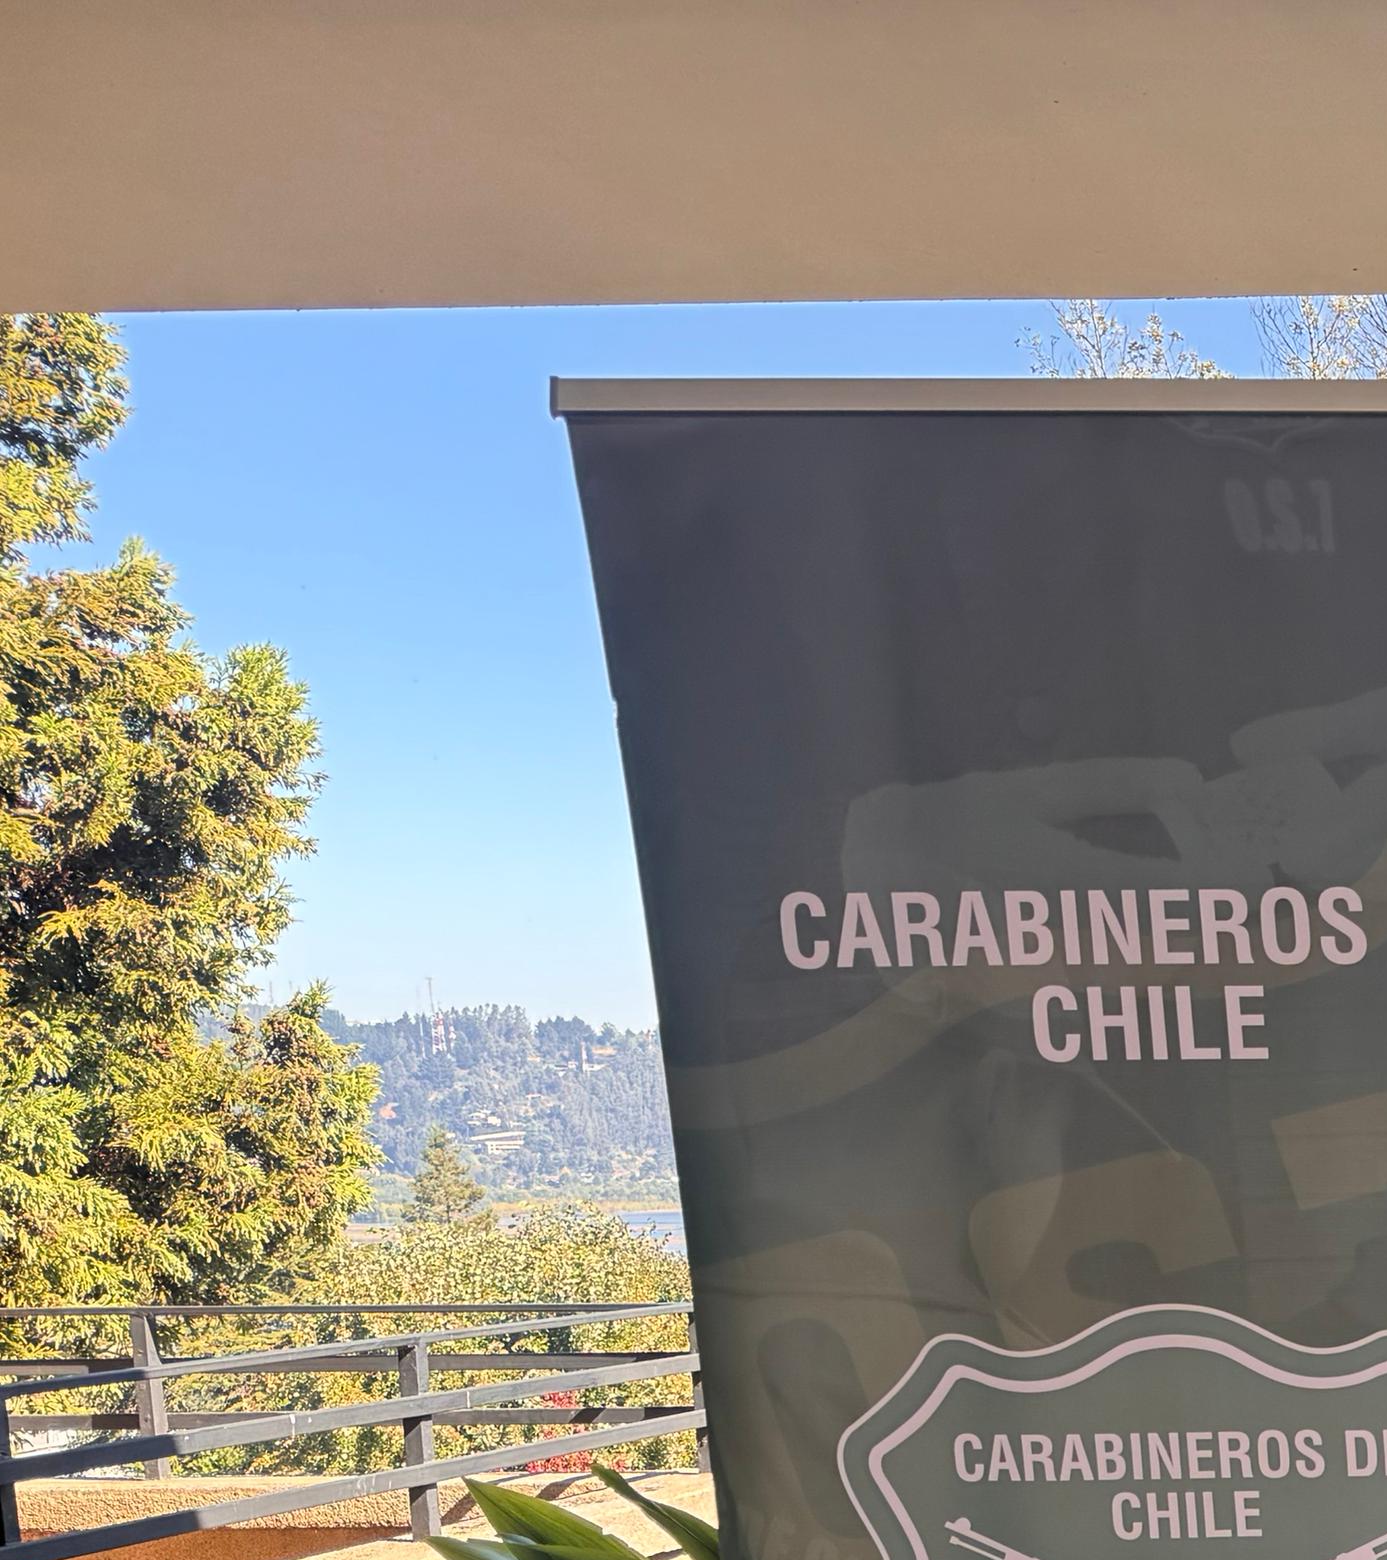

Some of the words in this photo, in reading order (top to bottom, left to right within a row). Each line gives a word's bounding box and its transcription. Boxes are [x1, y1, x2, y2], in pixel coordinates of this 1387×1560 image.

[779, 887, 1368, 969] CARABINEROS
[1032, 985, 1270, 1064] CHILE
[954, 1430, 1325, 1482] CARABINEROS
[1112, 1490, 1262, 1541] CHILE
